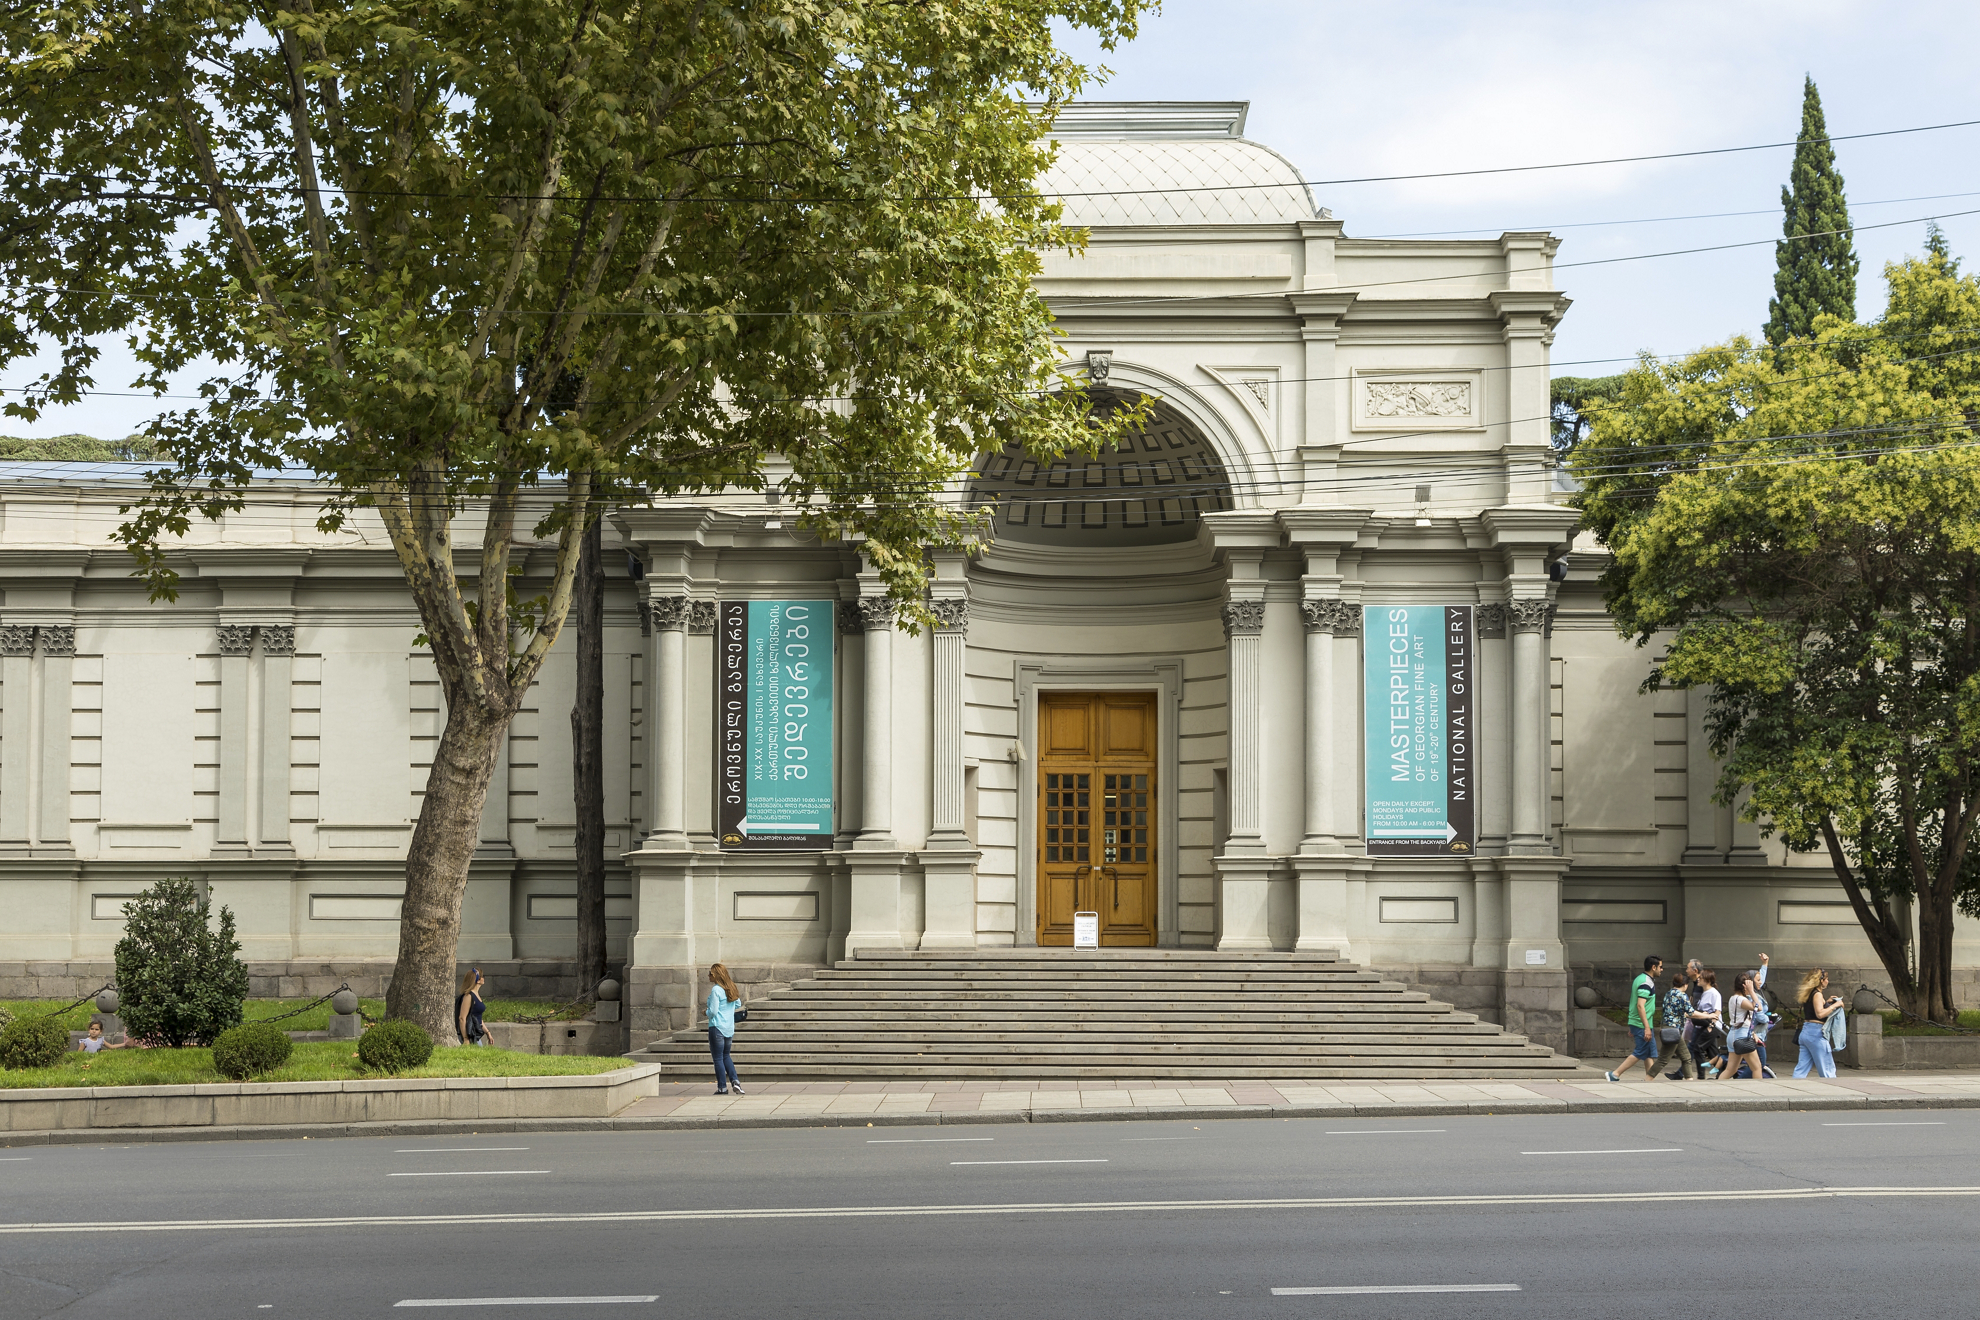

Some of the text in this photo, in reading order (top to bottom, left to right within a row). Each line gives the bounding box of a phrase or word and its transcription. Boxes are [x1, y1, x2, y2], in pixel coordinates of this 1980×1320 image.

[726, 606, 742, 804] ეროვნული გალერეა
[755, 695, 763, 744] საუკუნის
[756, 638, 764, 686] ნახევარი
[768, 605, 780, 780] ქართული სახვითი ხელოვნების
[784, 606, 809, 780] შედევრები
[1389, 609, 1410, 781] MASTERPIECES
[1414, 634, 1425, 781] OF GEORGIAN FINE ART
[1430, 683, 1438, 729] CENTURY
[1451, 608, 1466, 800] NATIONAL GALLERY
[755, 748, 763, 780] XIX-XX
[1431, 768, 1439, 781] OF
